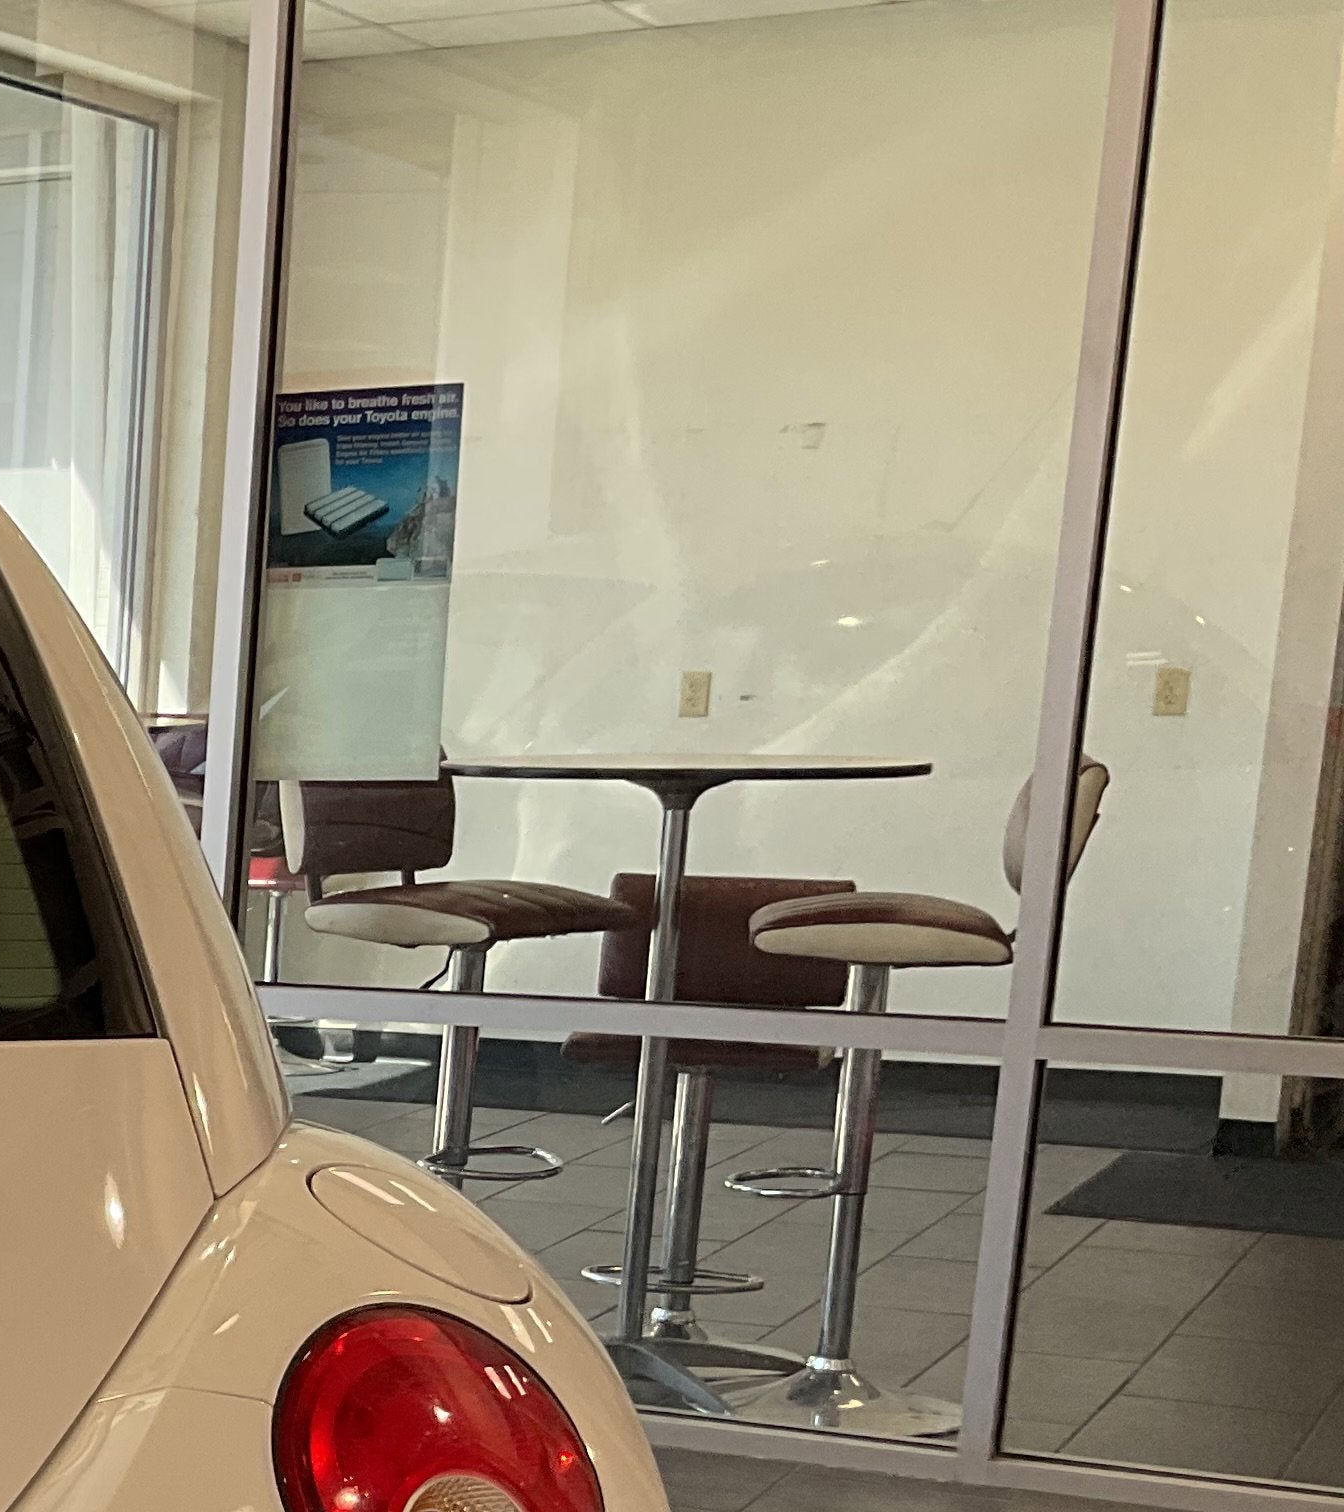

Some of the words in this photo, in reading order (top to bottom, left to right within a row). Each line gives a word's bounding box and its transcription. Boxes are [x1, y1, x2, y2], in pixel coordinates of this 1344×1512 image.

[278, 400, 302, 413] You
[305, 398, 328, 412] like
[331, 397, 345, 410] to
[348, 395, 399, 409] breathe
[401, 393, 435, 406] fresh
[277, 415, 296, 428] So
[298, 413, 330, 427] does
[333, 413, 362, 427] your
[364, 409, 408, 425] Toyota
